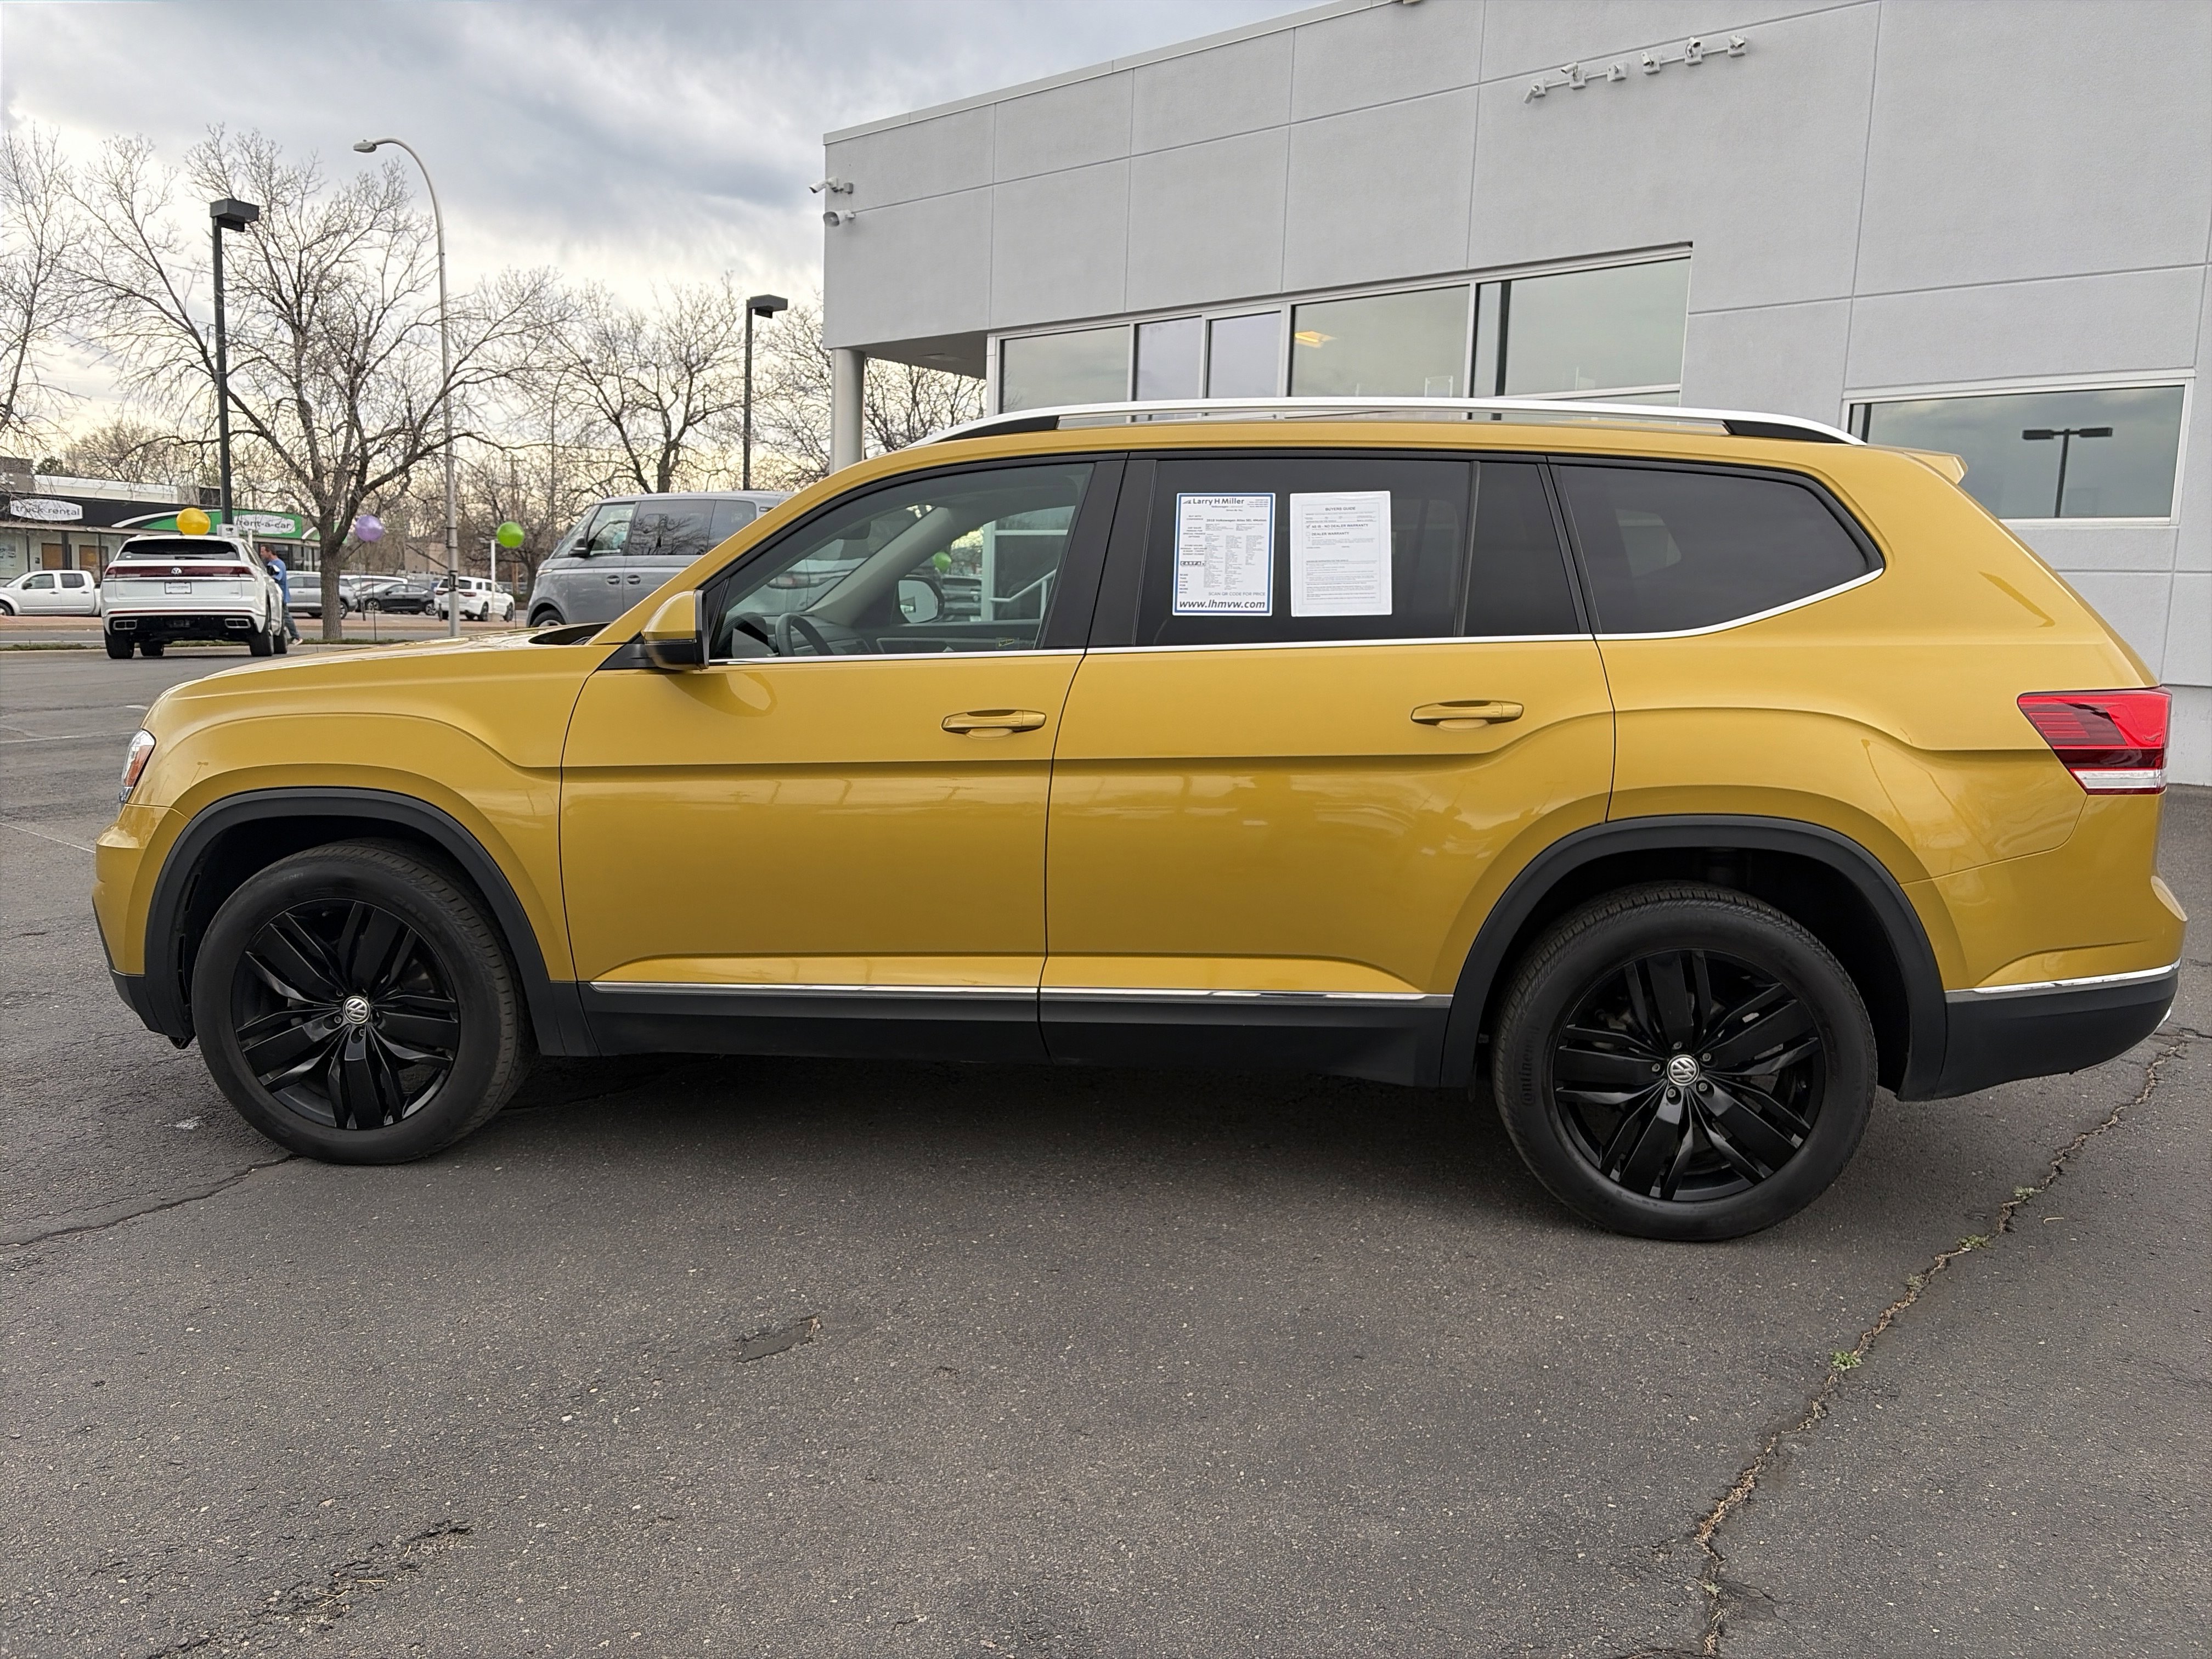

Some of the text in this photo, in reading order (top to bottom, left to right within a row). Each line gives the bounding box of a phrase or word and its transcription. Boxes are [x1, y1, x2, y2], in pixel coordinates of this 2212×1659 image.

[15, 504, 44, 514] truck
[239, 520, 292, 529] rent-a-car
[1180, 600, 1266, 608] www.lhmvw.com
